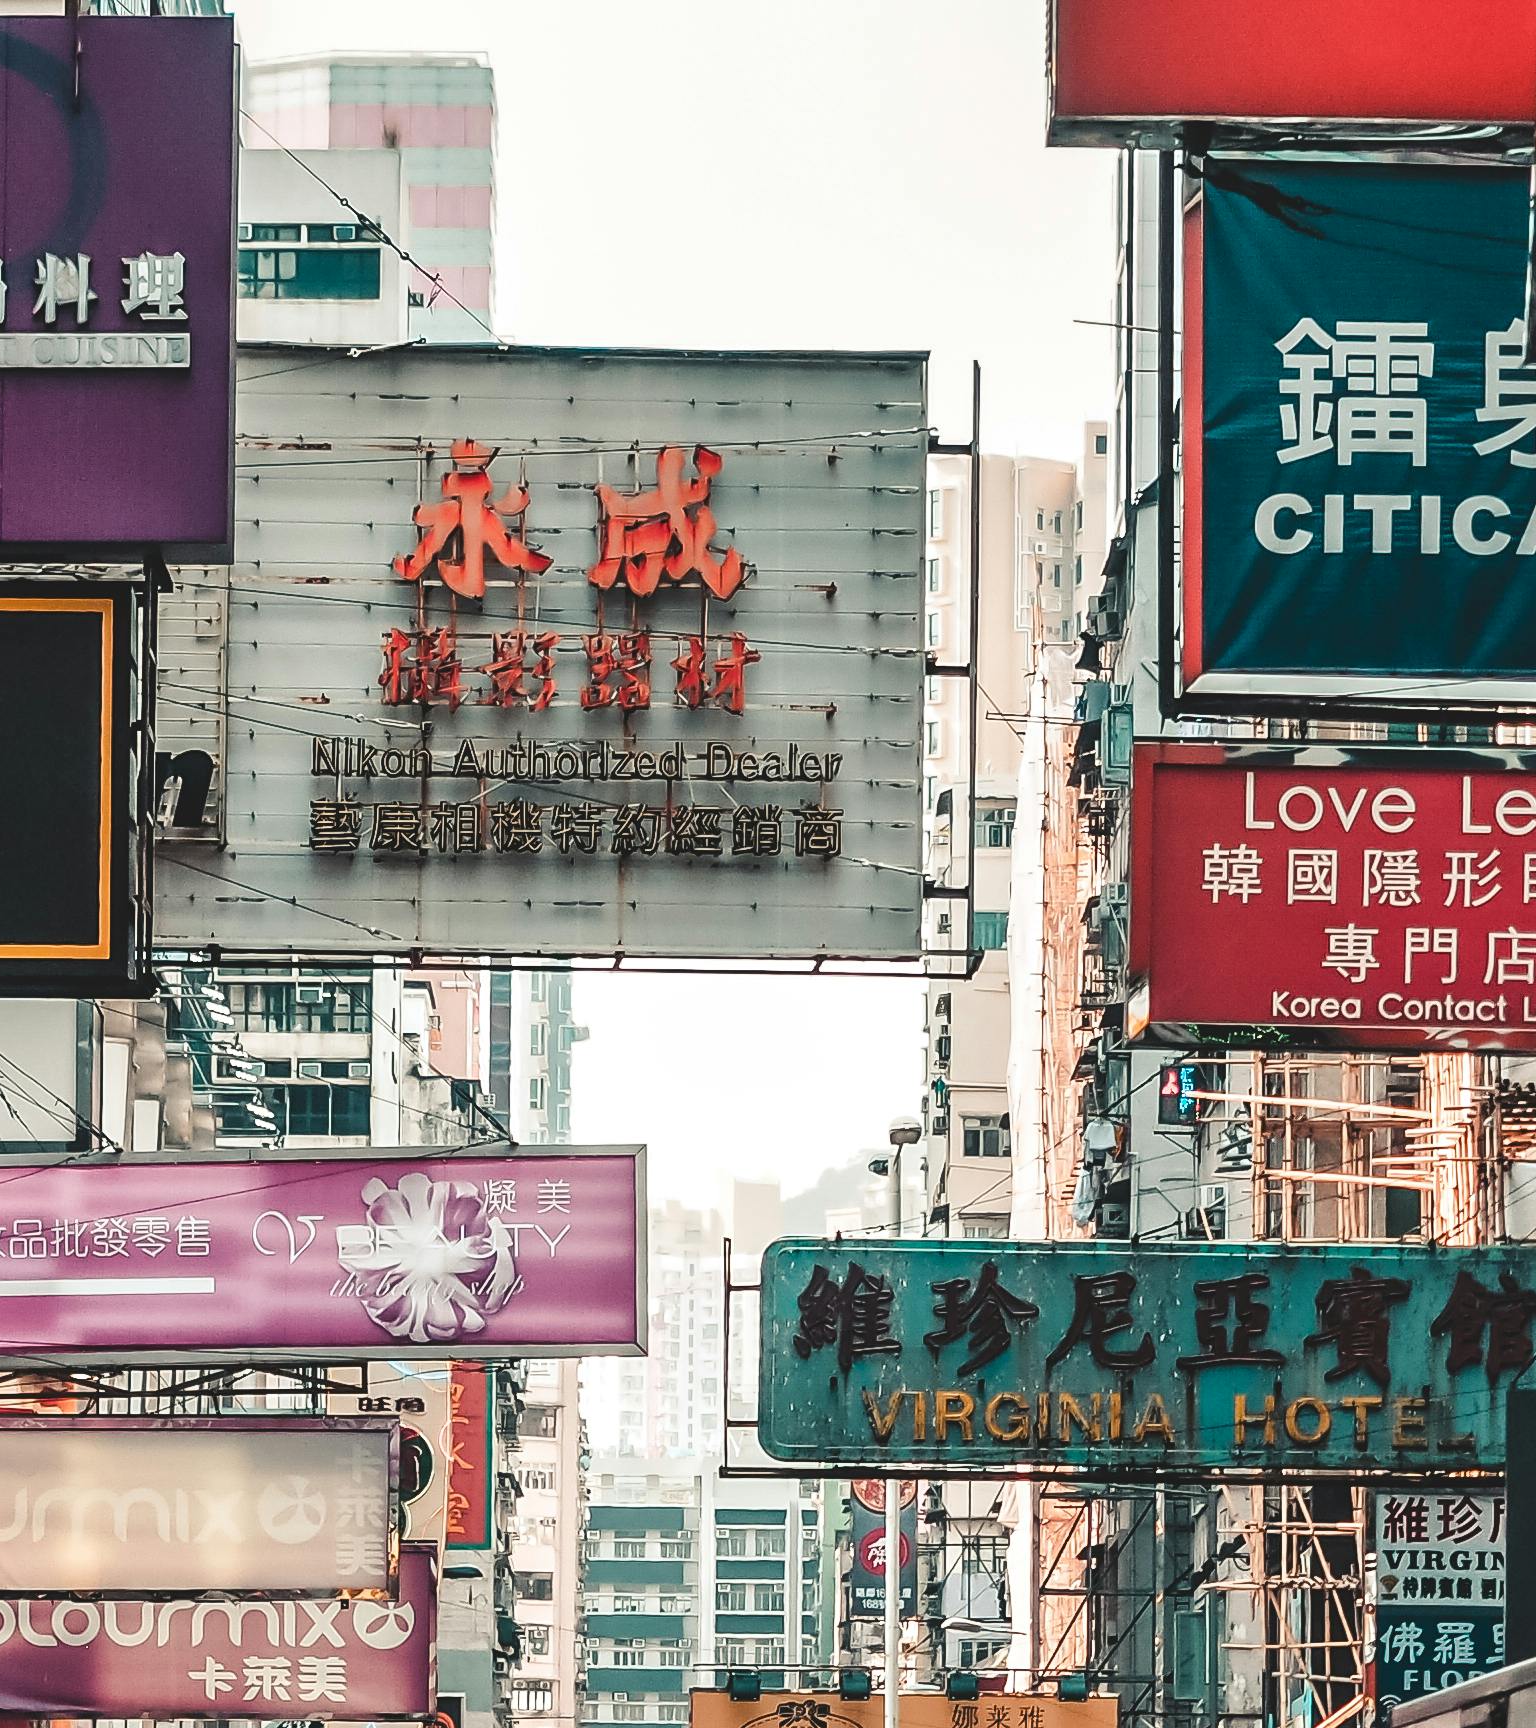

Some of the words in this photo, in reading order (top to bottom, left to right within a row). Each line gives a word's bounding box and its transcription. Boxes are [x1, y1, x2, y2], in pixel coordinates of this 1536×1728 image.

[394, 438, 756, 600] 永成
[311, 736, 436, 779] Nikon
[452, 738, 684, 782] Authorized
[706, 742, 843, 784] Dealer
[1243, 770, 1417, 836] Love
[1271, 990, 1366, 1022] Korea
[1377, 992, 1509, 1024] Contact
[482, 1178, 572, 1216] 凝美
[336, 1223, 570, 1262] BEAUTY
[862, 1390, 1176, 1446] VIRGINIA
[1234, 1394, 1475, 1451] HOTEL
[188, 1656, 349, 1704] 卡萊美
